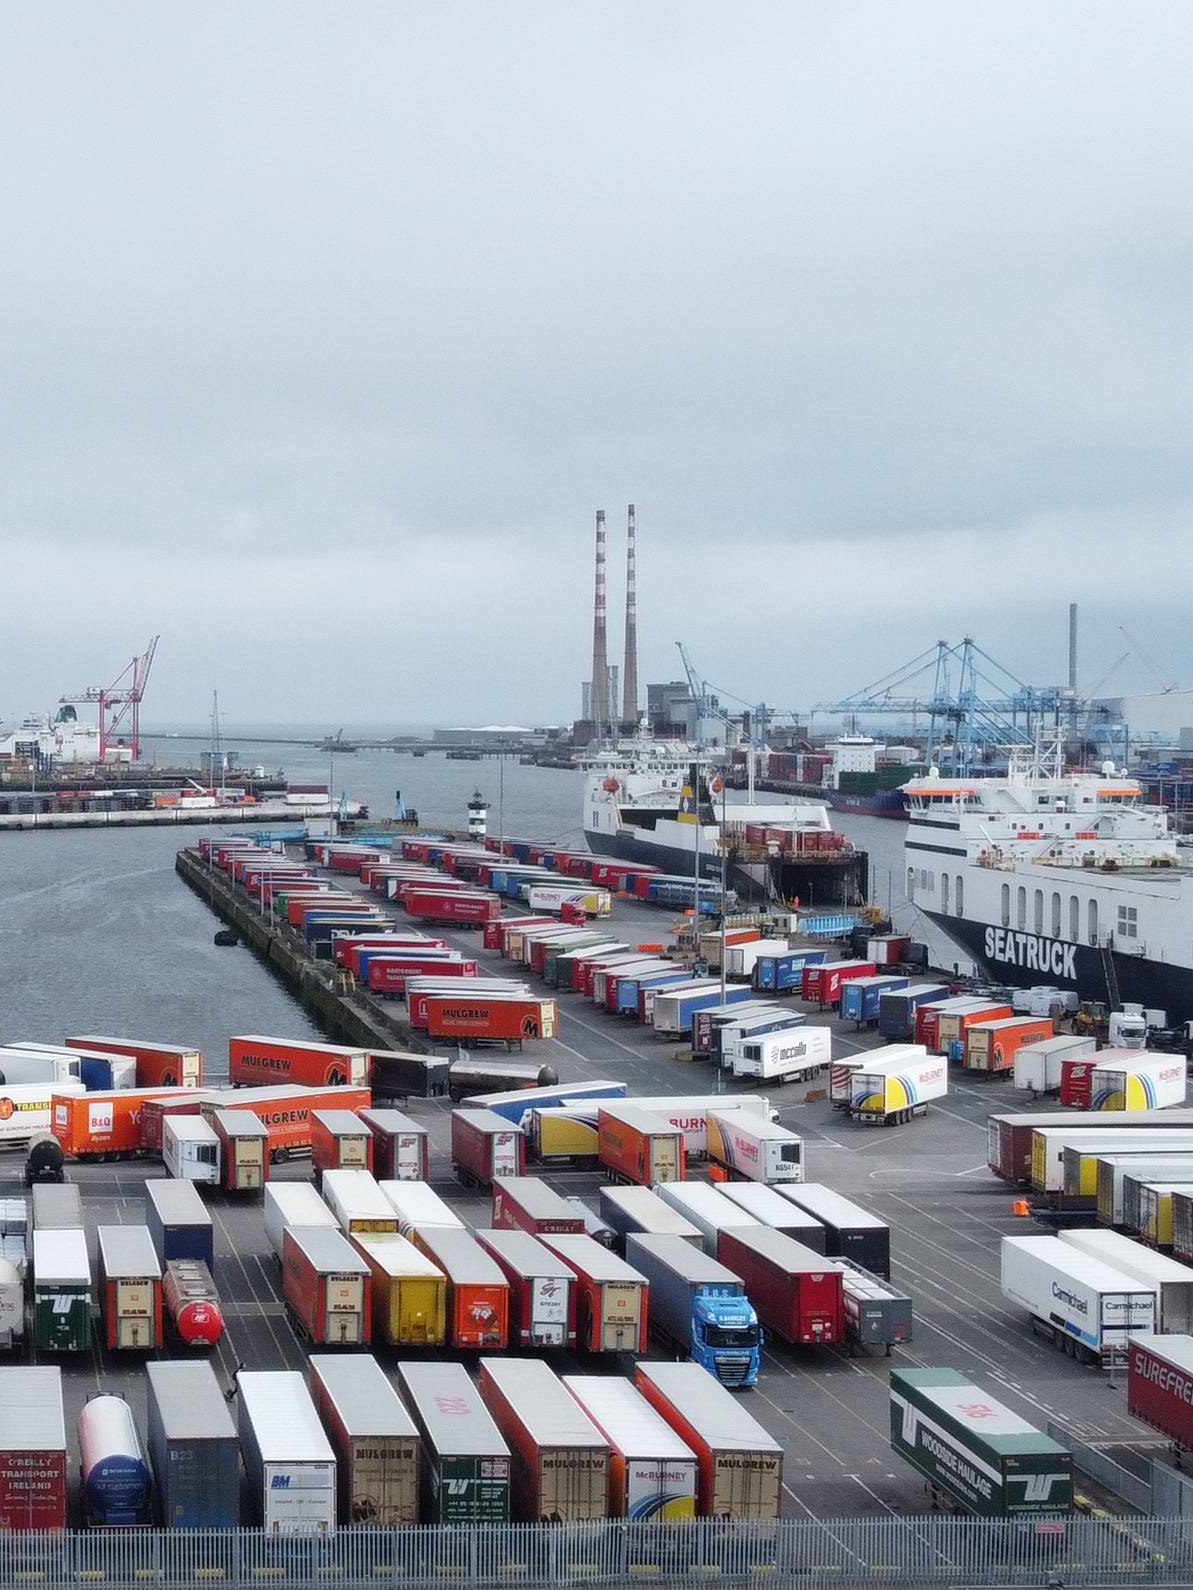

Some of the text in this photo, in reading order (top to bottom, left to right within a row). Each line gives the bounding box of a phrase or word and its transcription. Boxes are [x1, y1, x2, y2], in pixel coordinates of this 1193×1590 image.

[985, 926, 1077, 980] SEATRUCK
[443, 1009, 488, 1018] MULGREW
[242, 1055, 291, 1070] MULGREW
[1052, 1281, 1088, 1315] Carmichael
[1105, 1301, 1154, 1311] Carmichael
[543, 1460, 604, 1469] MULGREW
[718, 1460, 776, 1470] MULGREW
[921, 1429, 957, 1472] WOODSIDE
[957, 1460, 992, 1500] HAULAGE
[1, 1470, 59, 1478] TRANSPORT
[635, 1471, 687, 1480] McBURNEY
[9, 1482, 51, 1490] IRELAND
[271, 1475, 291, 1487] BM
